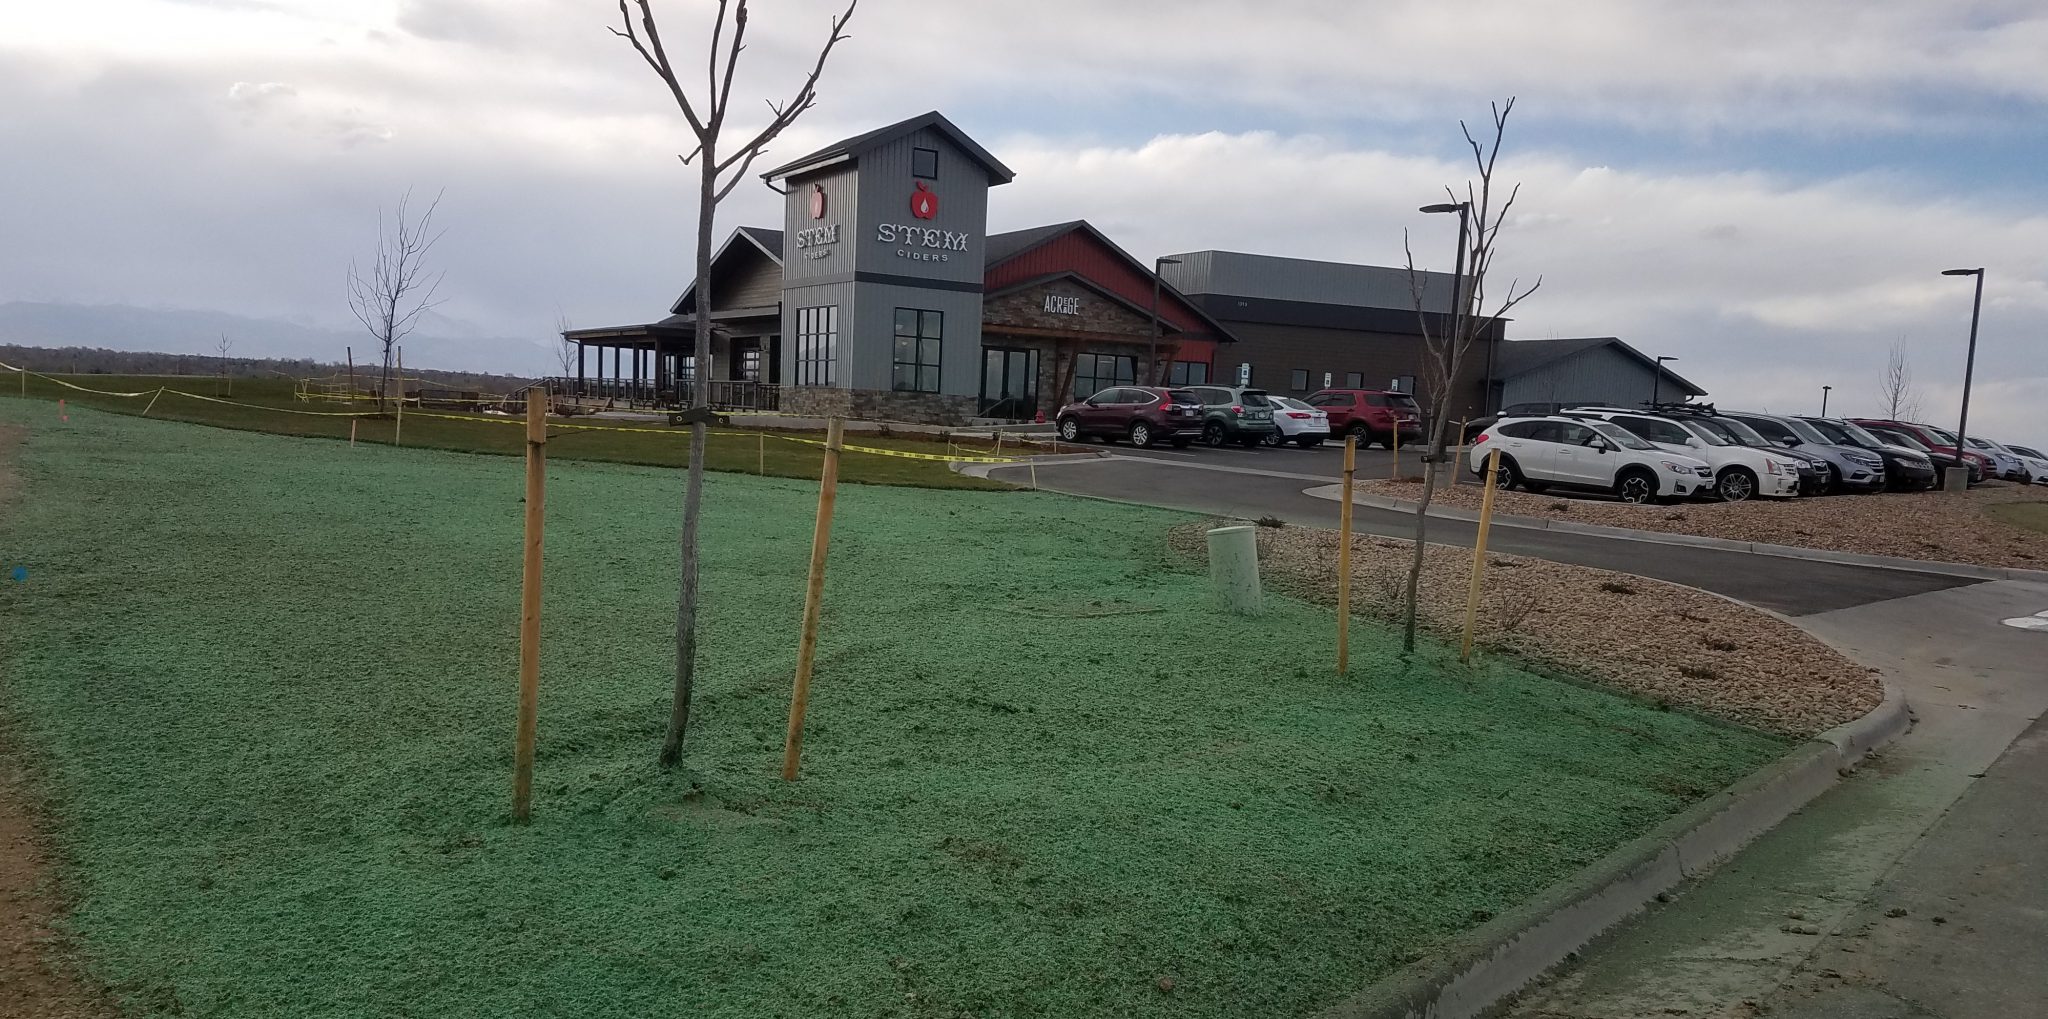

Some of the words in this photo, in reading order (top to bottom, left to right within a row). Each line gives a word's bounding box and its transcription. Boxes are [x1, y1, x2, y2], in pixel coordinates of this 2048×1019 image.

[796, 223, 838, 249] STEM
[877, 223, 968, 252] STEM
[896, 249, 949, 262] CIDERS
